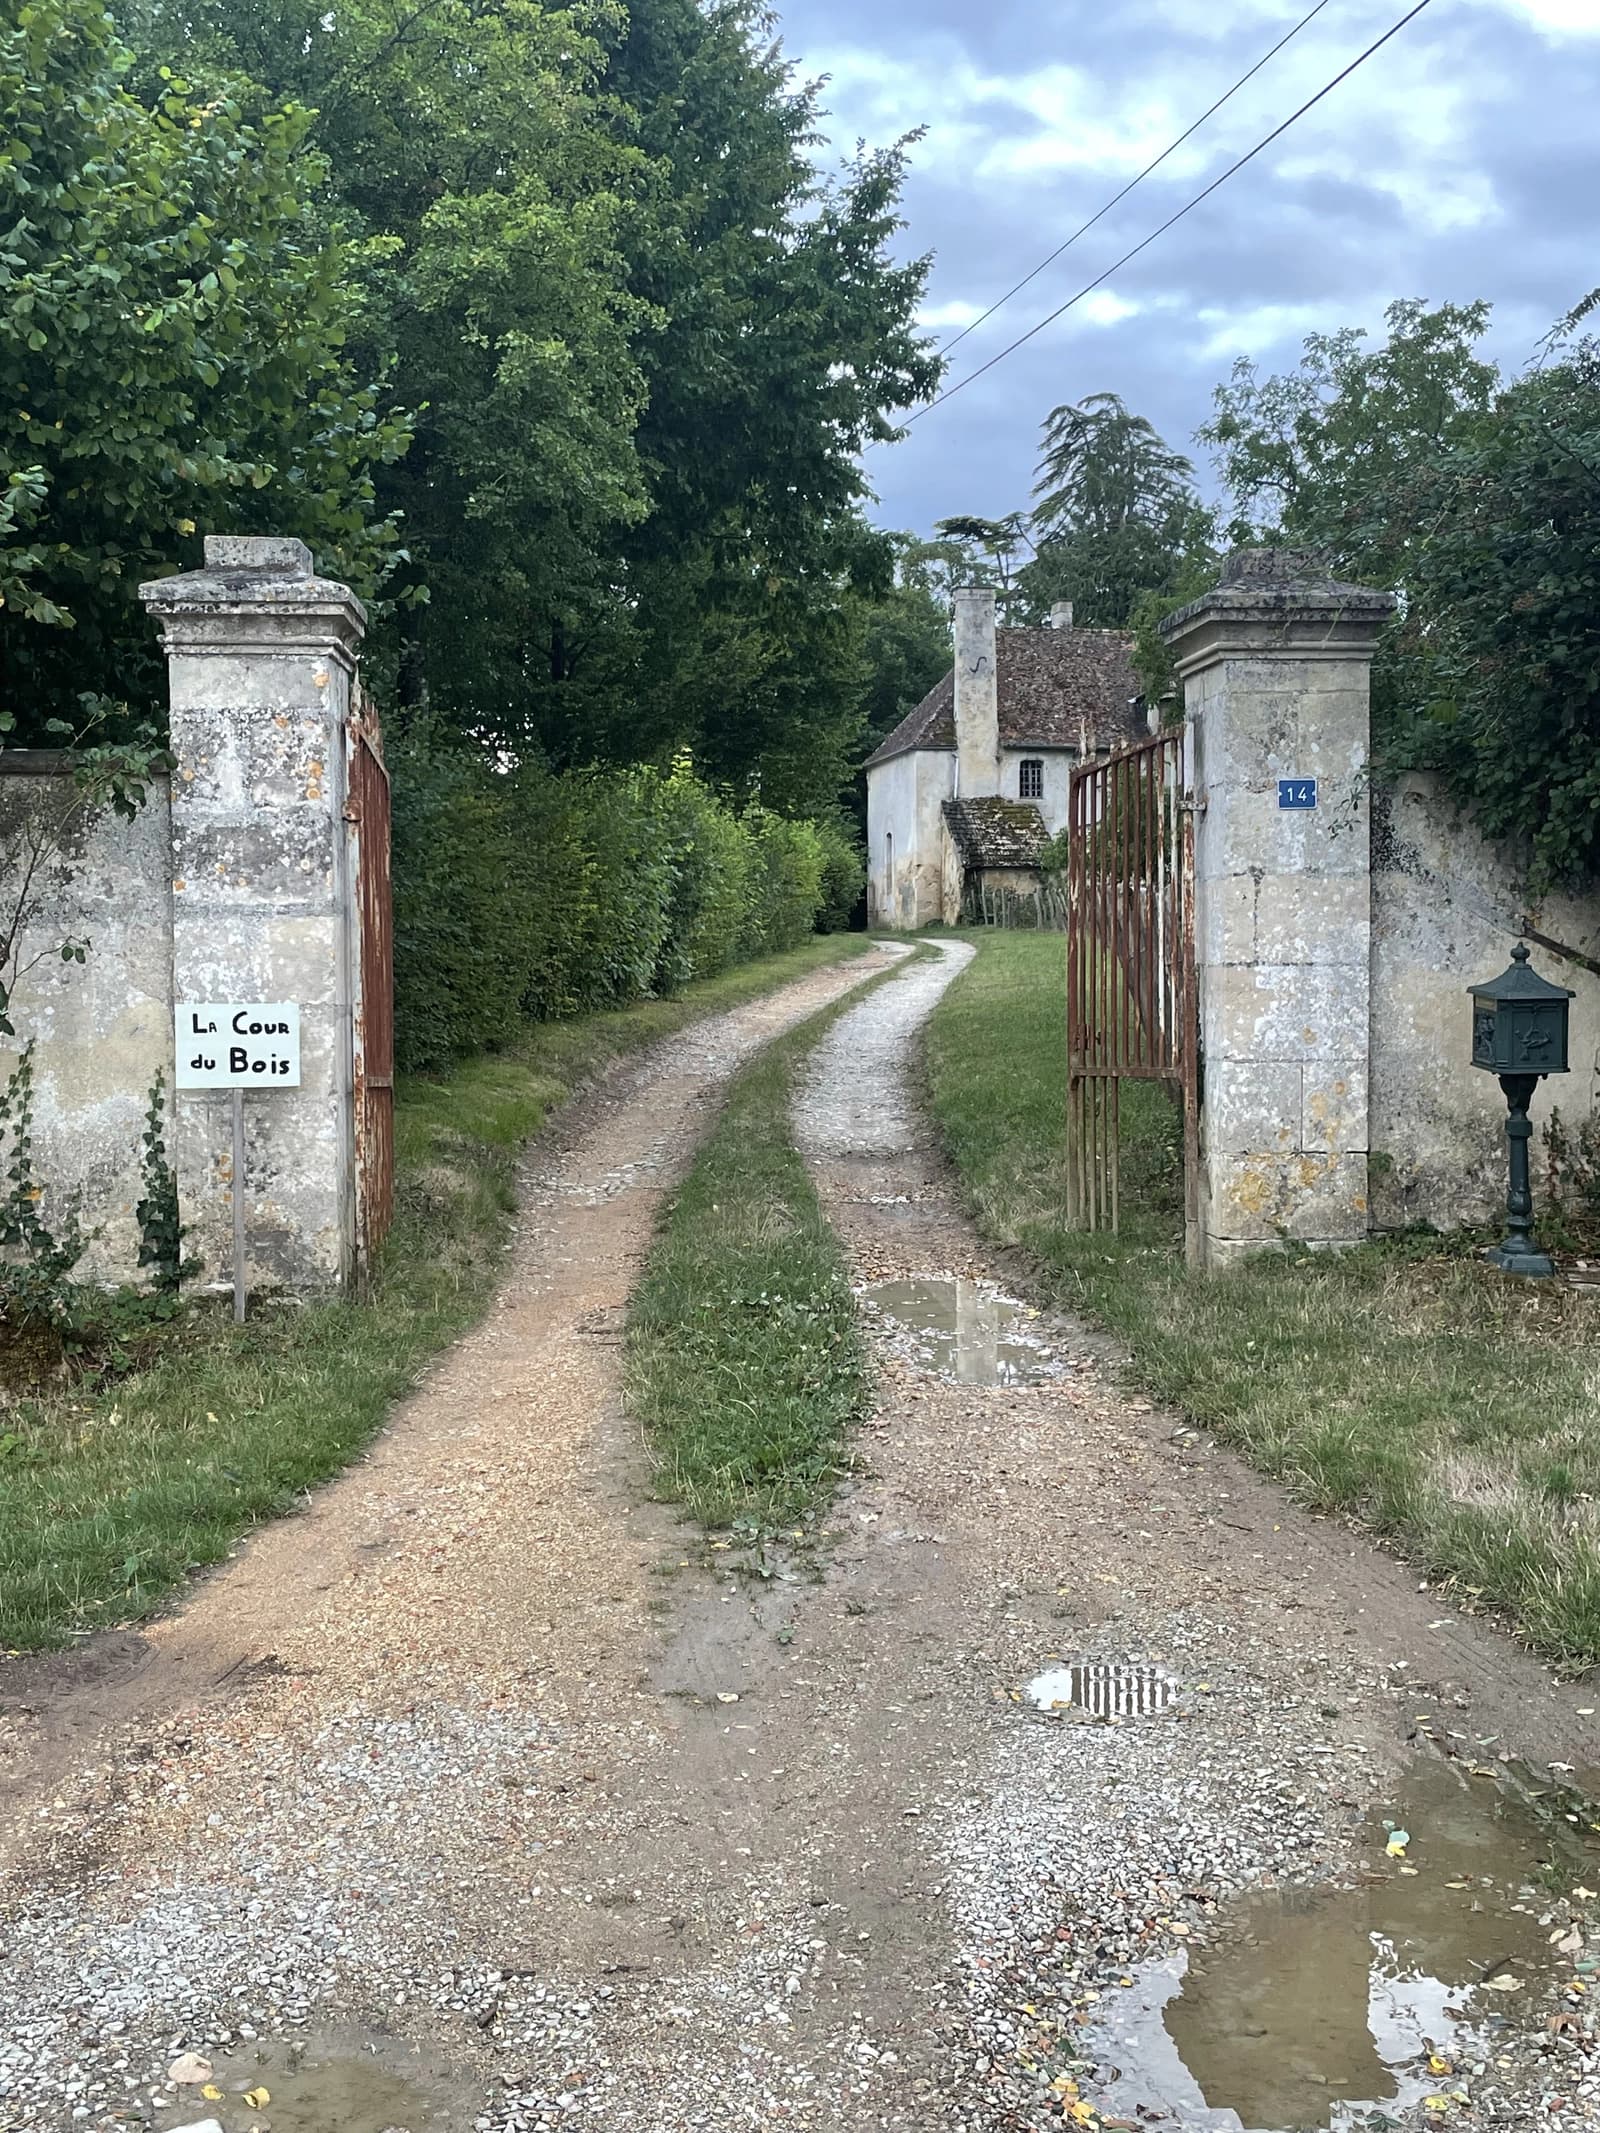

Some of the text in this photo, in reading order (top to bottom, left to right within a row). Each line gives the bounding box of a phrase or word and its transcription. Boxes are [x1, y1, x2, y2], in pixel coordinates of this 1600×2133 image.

[1287, 786, 1307, 802] 14
[191, 1047, 290, 1075] du Bois
